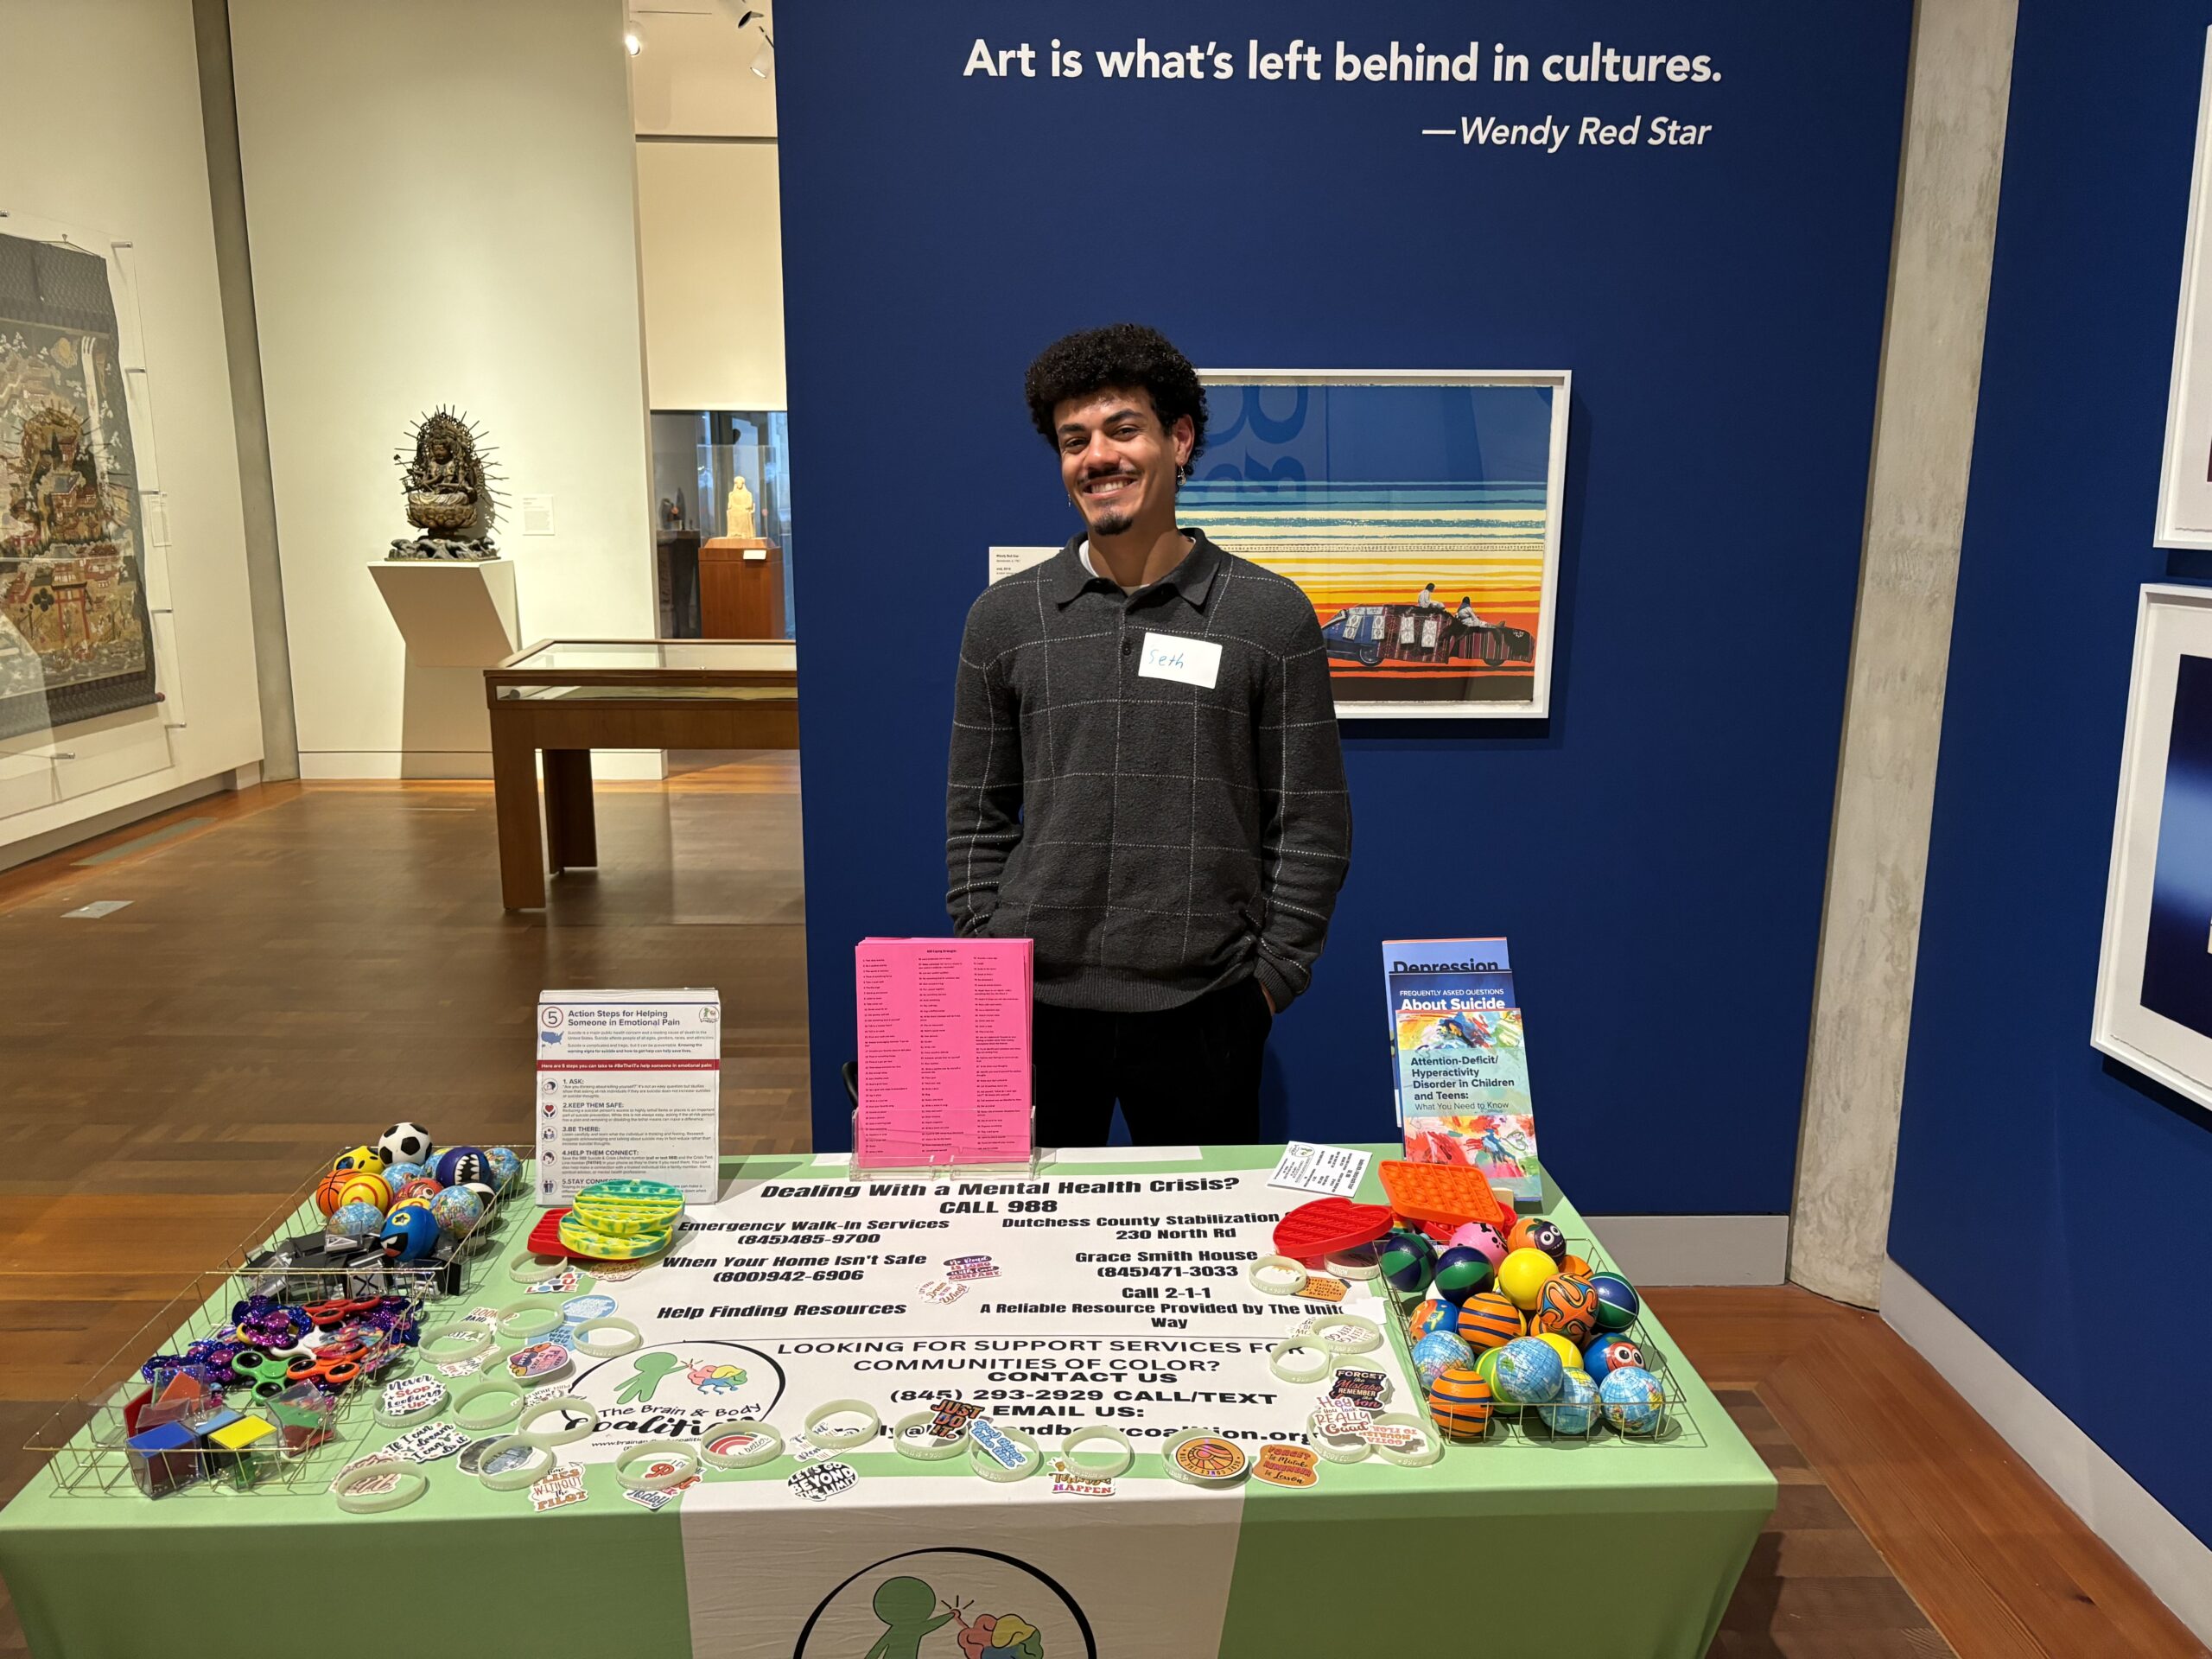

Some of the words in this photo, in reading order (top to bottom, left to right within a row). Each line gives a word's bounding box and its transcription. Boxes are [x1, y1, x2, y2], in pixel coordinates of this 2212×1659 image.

[963, 39, 1036, 78] Art
[1051, 40, 1083, 78] is
[1095, 41, 1234, 79] what's
[1248, 40, 1321, 81] left
[1335, 41, 1478, 82] behind
[1493, 42, 1529, 82] in
[1542, 41, 1723, 83] cultures.
[1578, 117, 1640, 145] Red
[1648, 117, 1712, 145] Star
[1149, 649, 1184, 669] Seth
[1394, 958, 1498, 972] Depression
[1402, 999, 1446, 1010] About
[1451, 997, 1505, 1009] Suicide
[548, 1011, 557, 1024] 5
[597, 1010, 620, 1019] Steps
[1411, 1055, 1498, 1066] Attention-Deficit/
[1412, 1067, 1479, 1079] Hyperactivity
[1413, 1078, 1457, 1089] Disorder
[1459, 1078, 1469, 1088] in
[1471, 1077, 1515, 1088] Children
[1414, 1090, 1433, 1100] and
[1435, 1090, 1469, 1100] Teens:
[760, 1185, 862, 1198] Dealing
[869, 1184, 927, 1196] With
[934, 1186, 950, 1196] a
[958, 1181, 1049, 1196] Mental
[1058, 1180, 1142, 1194] Health
[1149, 1177, 1240, 1192] Crisis?
[940, 1201, 999, 1214] CALL
[1007, 1200, 1058, 1213] 988
[678, 1219, 785, 1232] Emergency
[791, 1219, 862, 1230] Walk-In
[867, 1218, 950, 1229] Services
[1002, 1216, 1091, 1228] Dutchess
[1096, 1215, 1161, 1227] County
[1166, 1211, 1280, 1224] Stabilization
[737, 1233, 881, 1245] (845)485-9700
[1116, 1230, 1152, 1240] 230
[1157, 1228, 1208, 1239] North
[1213, 1228, 1236, 1238] Rd
[663, 1256, 718, 1268] When
[723, 1255, 768, 1268] Your
[772, 1255, 830, 1267] Home
[834, 1254, 879, 1266] Isn't
[883, 1253, 927, 1265] Safe
[1075, 1252, 1131, 1262] Grace
[1137, 1251, 1193, 1262] Smith
[1198, 1250, 1258, 1261] House
[713, 1269, 864, 1282] (800)942-6906
[1096, 1266, 1238, 1278] (845)471-3033
[1122, 1287, 1159, 1299] Call
[1165, 1287, 1211, 1298] 2-1-1
[657, 1306, 705, 1320] Help
[709, 1305, 788, 1319] Finding
[794, 1303, 907, 1316] Resources
[980, 1304, 993, 1313] A
[996, 1303, 1067, 1313] Reliable
[1071, 1303, 1155, 1313] Resource
[1160, 1303, 1238, 1314] Provided
[1243, 1304, 1264, 1317] by
[1268, 1304, 1300, 1314] The
[1305, 1304, 1344, 1315] Unit
[1152, 1317, 1187, 1330] Way
[778, 1342, 906, 1355] LOOKING
[912, 1341, 969, 1352] FOR
[974, 1339, 1103, 1352] SUPPORT
[1109, 1340, 1242, 1353] SERVICES
[854, 1358, 1057, 1371] COMMUNITIES
[1065, 1358, 1095, 1370] OF
[1100, 1359, 1221, 1372] COLOR?
[389, 1375, 432, 1390] Never
[988, 1371, 1128, 1383] CONTACT
[1132, 1372, 1178, 1383] US
[1338, 1371, 1384, 1380] FORGET
[396, 1385, 430, 1397] Stop
[1336, 1380, 1383, 1391] Mistake
[1338, 1388, 1376, 1396] REMEMBER
[387, 1389, 442, 1408] Looking
[890, 1389, 963, 1403] (845)
[973, 1389, 1103, 1402] 293-2929
[1114, 1390, 1277, 1405] CALL/TEXT
[1317, 1396, 1352, 1408] Hey
[599, 1406, 634, 1417] The
[641, 1404, 686, 1415] Brain
[715, 1402, 761, 1417] Body
[931, 1399, 985, 1419] JUST
[993, 1406, 1086, 1416] EMAIL
[1095, 1406, 1144, 1418] US:
[933, 1413, 966, 1427] DO
[1315, 1412, 1371, 1425] REALLY
[929, 1426, 957, 1439] IT.
[1325, 1421, 1369, 1433] Good
[386, 1442, 402, 1452] If
[411, 1426, 434, 1438] can
[416, 1425, 454, 1447] dream
[974, 1421, 1001, 1439] good
[996, 1437, 1026, 1463] things
[423, 1442, 445, 1455] can
[442, 1444, 457, 1453] do
[972, 1427, 994, 1449] take
[993, 1446, 1015, 1468] time
[1268, 1445, 1311, 1460] FORGET
[1278, 1455, 1307, 1467] Mistake
[792, 1464, 822, 1483] LET'S
[792, 1469, 854, 1492] BEYOND
[1273, 1471, 1303, 1484] Lesson
[534, 1478, 582, 1497] WITHOUT
[797, 1489, 819, 1498] THE
[821, 1478, 855, 1497] LIMIT
[1052, 1484, 1111, 1494] HAPPEN
[537, 1490, 588, 1510] PILOT
[626, 1489, 670, 1508] Today
